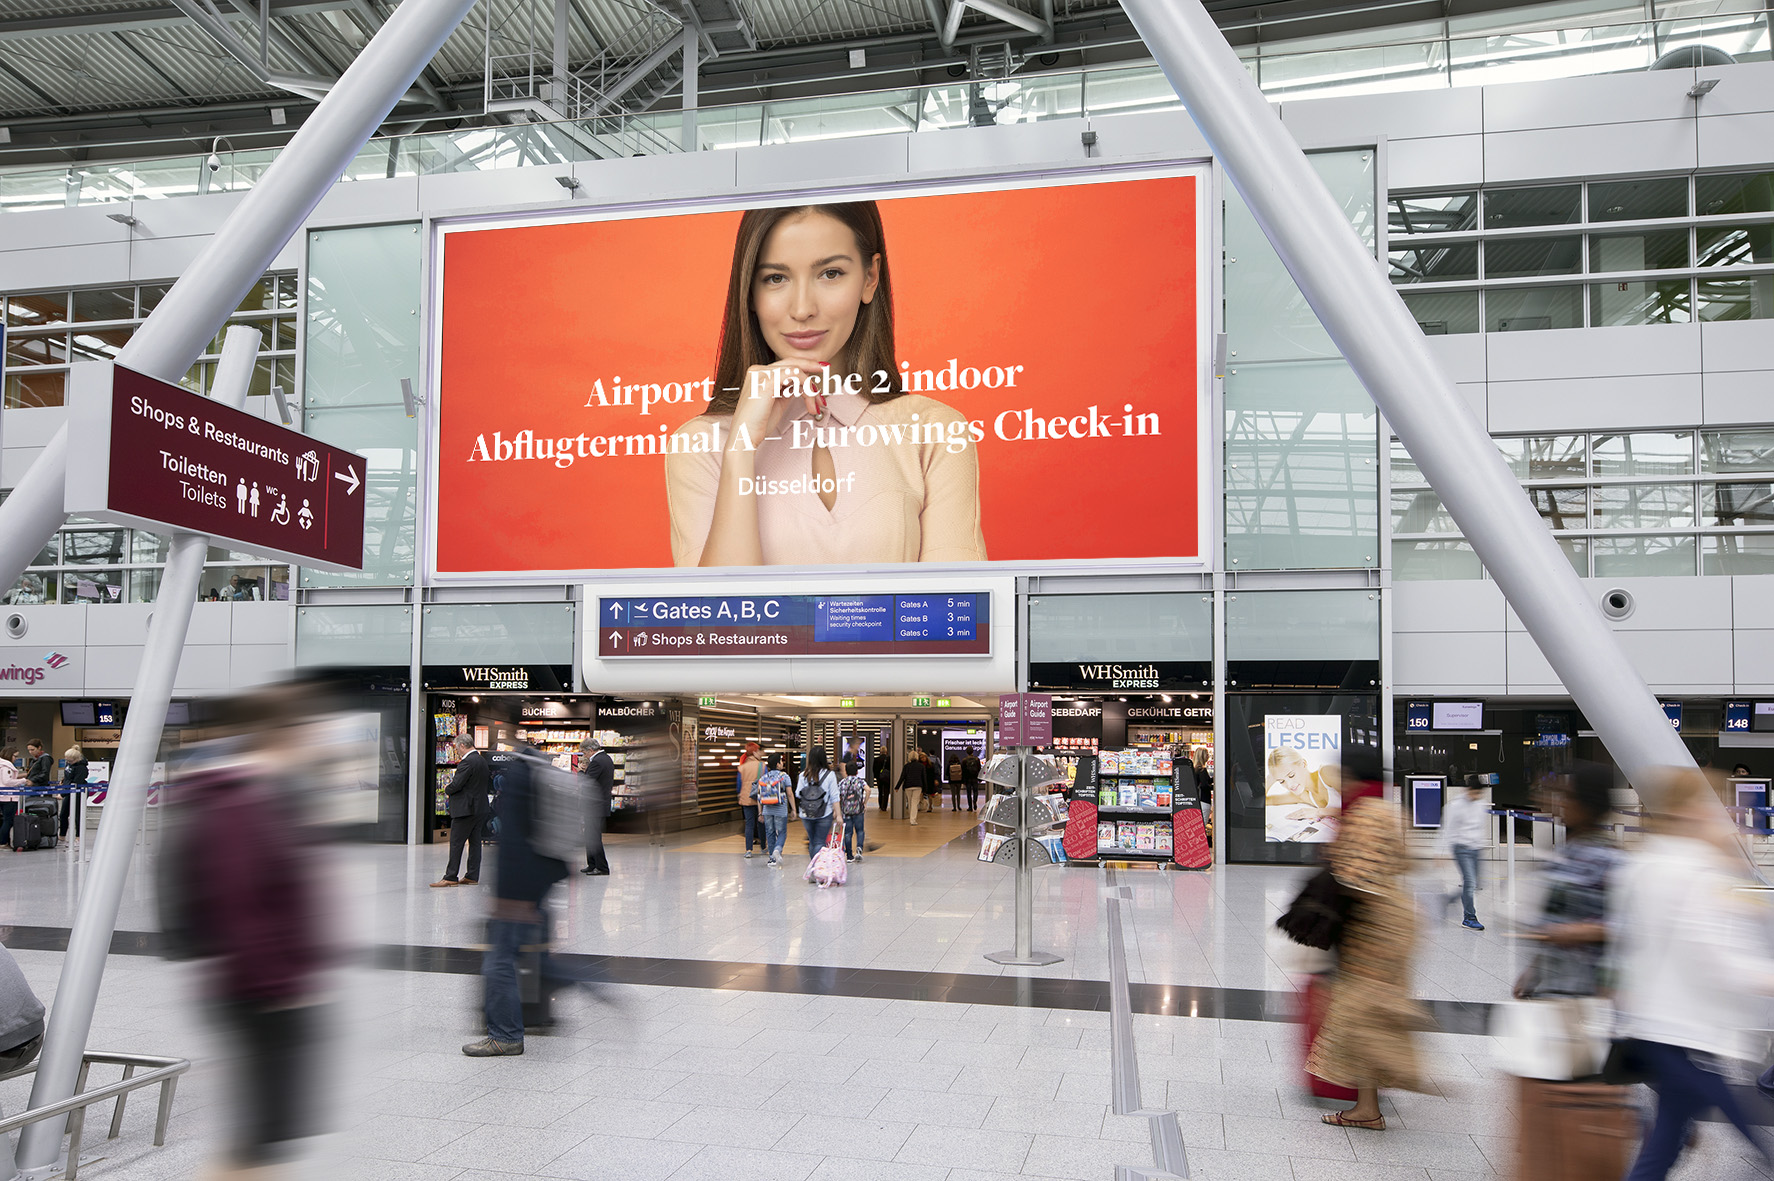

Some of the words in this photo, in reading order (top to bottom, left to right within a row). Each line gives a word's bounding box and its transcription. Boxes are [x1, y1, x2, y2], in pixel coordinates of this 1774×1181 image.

[584, 375, 716, 415] Airport
[748, 364, 863, 400] Fläche
[871, 369, 891, 394] 2
[900, 358, 1024, 393] indoor
[130, 396, 184, 430] Shops
[188, 416, 201, 435] &
[204, 421, 290, 466] Restaurants
[466, 422, 720, 469] Abflugterminal
[729, 421, 757, 451] A
[790, 413, 985, 454] Eurowings
[993, 403, 1162, 441] Check-in
[159, 450, 227, 487] Toiletten
[738, 471, 856, 496] Düsseldorf
[179, 480, 227, 510] Toilets
[265, 485, 279, 497] WC
[900, 601, 921, 609] Gates
[947, 598, 954, 608] 5
[652, 602, 712, 619] Gates
[947, 612, 954, 622] 3
[900, 629, 921, 637] Gates
[922, 629, 929, 637] C
[947, 626, 954, 636] 3
[652, 633, 693, 648] Shops
[695, 633, 706, 645] &
[709, 633, 788, 645] Restaurants
[462, 667, 528, 681] WHSmith
[1079, 665, 1159, 679] WHSmith
[490, 681, 528, 689] EXPRESS
[1112, 680, 1159, 688] EXPRESS
[441, 699, 456, 708] KIDS
[1004, 700, 1018, 709] Airport
[1030, 699, 1048, 709] Airport
[522, 707, 557, 716] BÜCHER
[598, 707, 655, 716] MALBÜCHER
[1004, 710, 1016, 718] Guide
[1030, 710, 1046, 718] Guide
[1128, 706, 1181, 717] GEKÜHLTE
[99, 715, 113, 723] 153
[1268, 718, 1306, 730] READ
[1409, 718, 1429, 727] 150
[1728, 718, 1749, 728] 148
[1268, 732, 1338, 750] LESEN
